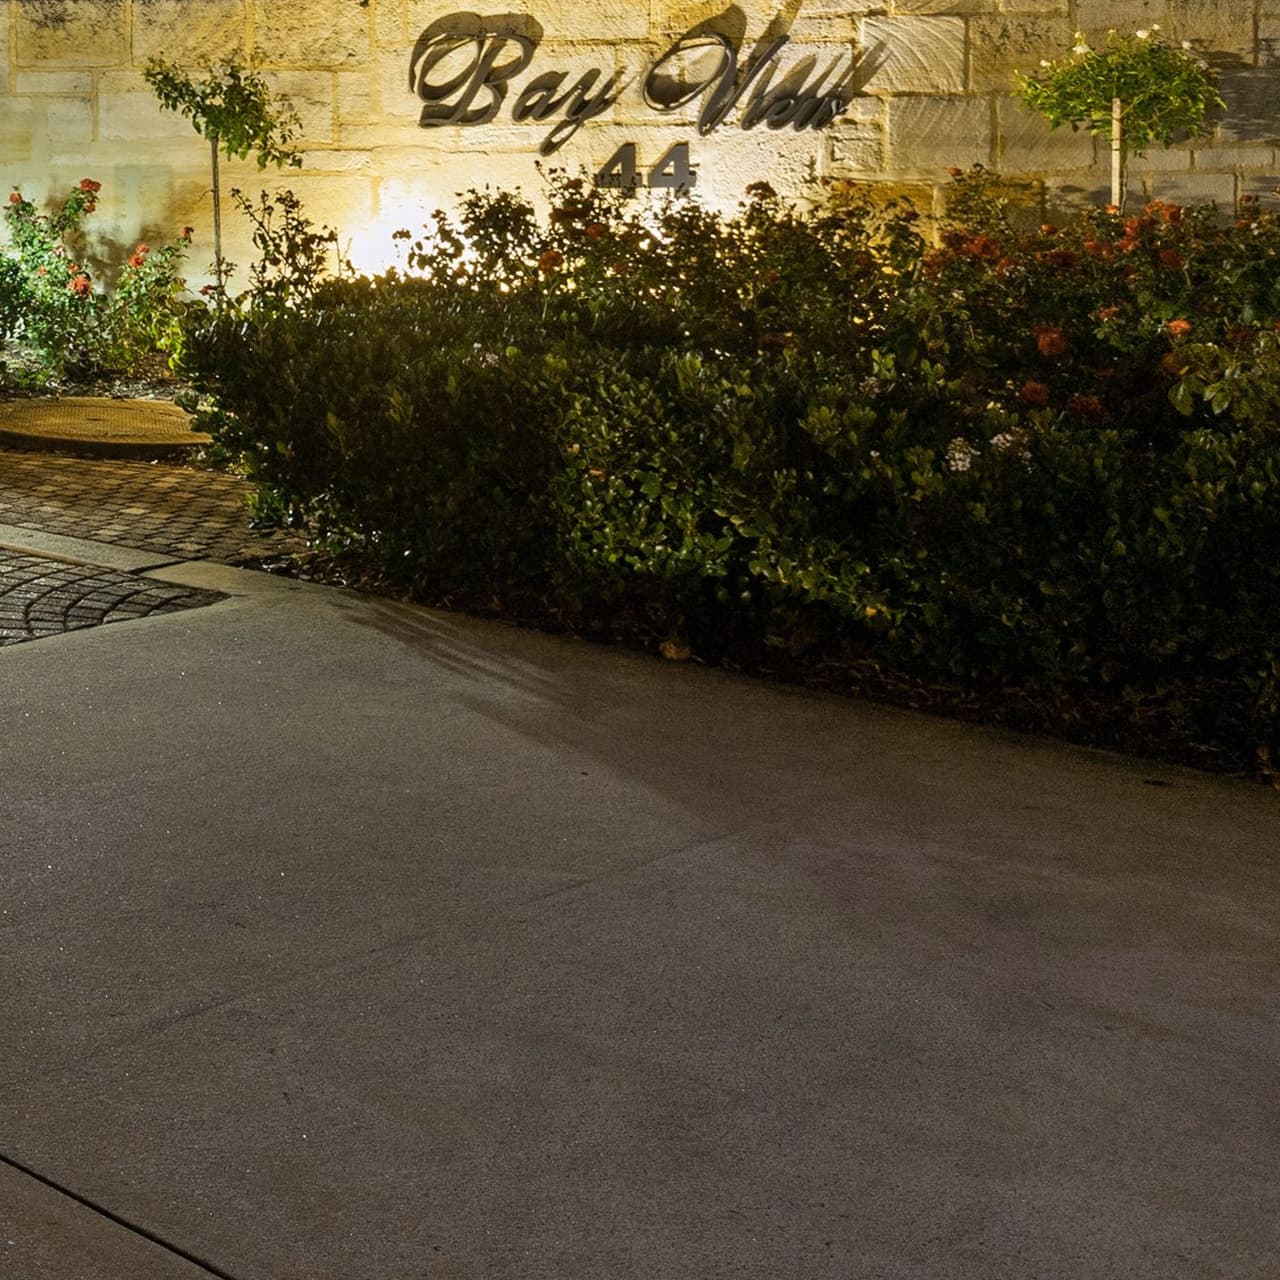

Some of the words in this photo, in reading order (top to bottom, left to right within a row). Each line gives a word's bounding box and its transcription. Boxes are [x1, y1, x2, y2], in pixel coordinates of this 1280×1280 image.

[411, 23, 619, 156] Bay
[642, 29, 848, 136] View
[594, 141, 697, 200] 44
